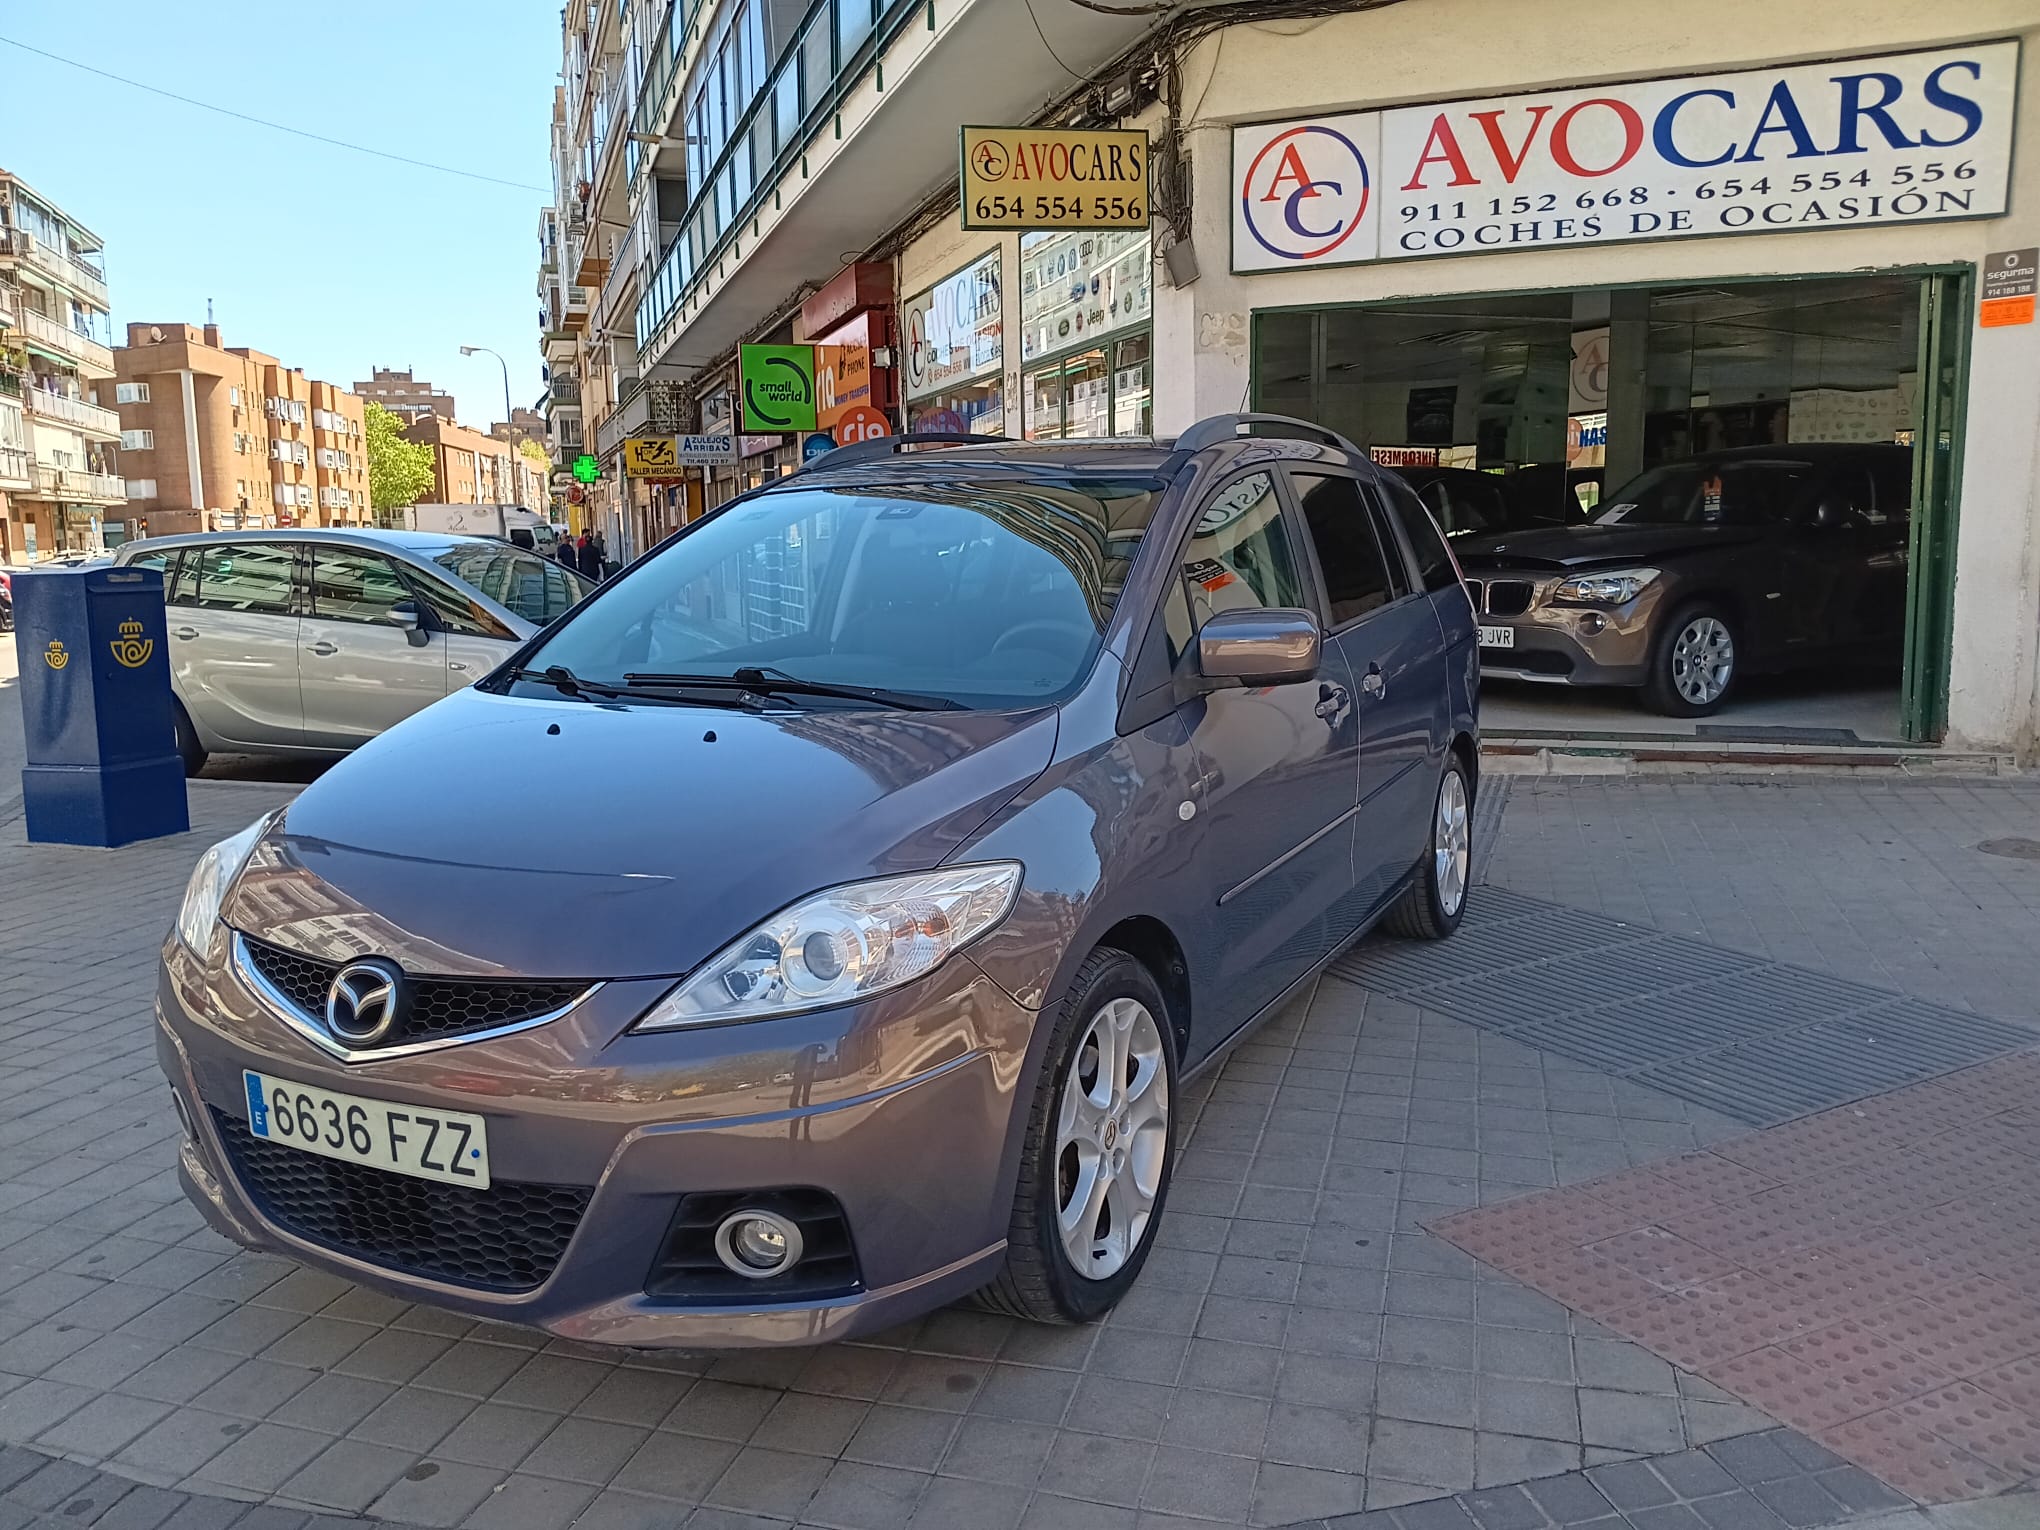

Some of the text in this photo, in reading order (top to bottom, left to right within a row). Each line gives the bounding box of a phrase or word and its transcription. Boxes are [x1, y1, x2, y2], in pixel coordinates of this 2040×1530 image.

[1400, 61, 1983, 191] AVOCARS
[1012, 142, 1141, 182] AVOCARS
[1400, 160, 1977, 224] 911 152 668 654 554 556
[976, 195, 1142, 220] 654 554 556
[1400, 187, 1976, 251] COCHES DE OCASIÓN
[1986, 267, 2035, 280] segurma
[1087, 308, 1105, 326] Jeep
[847, 358, 865, 377] PHONE
[759, 381, 791, 393] small
[816, 347, 835, 414] ria
[768, 390, 802, 402] world
[630, 467, 650, 475] TALLER
[1487, 629, 1511, 644] JVR
[255, 1111, 262, 1126] E
[272, 1087, 476, 1177] 6636 FZZ
